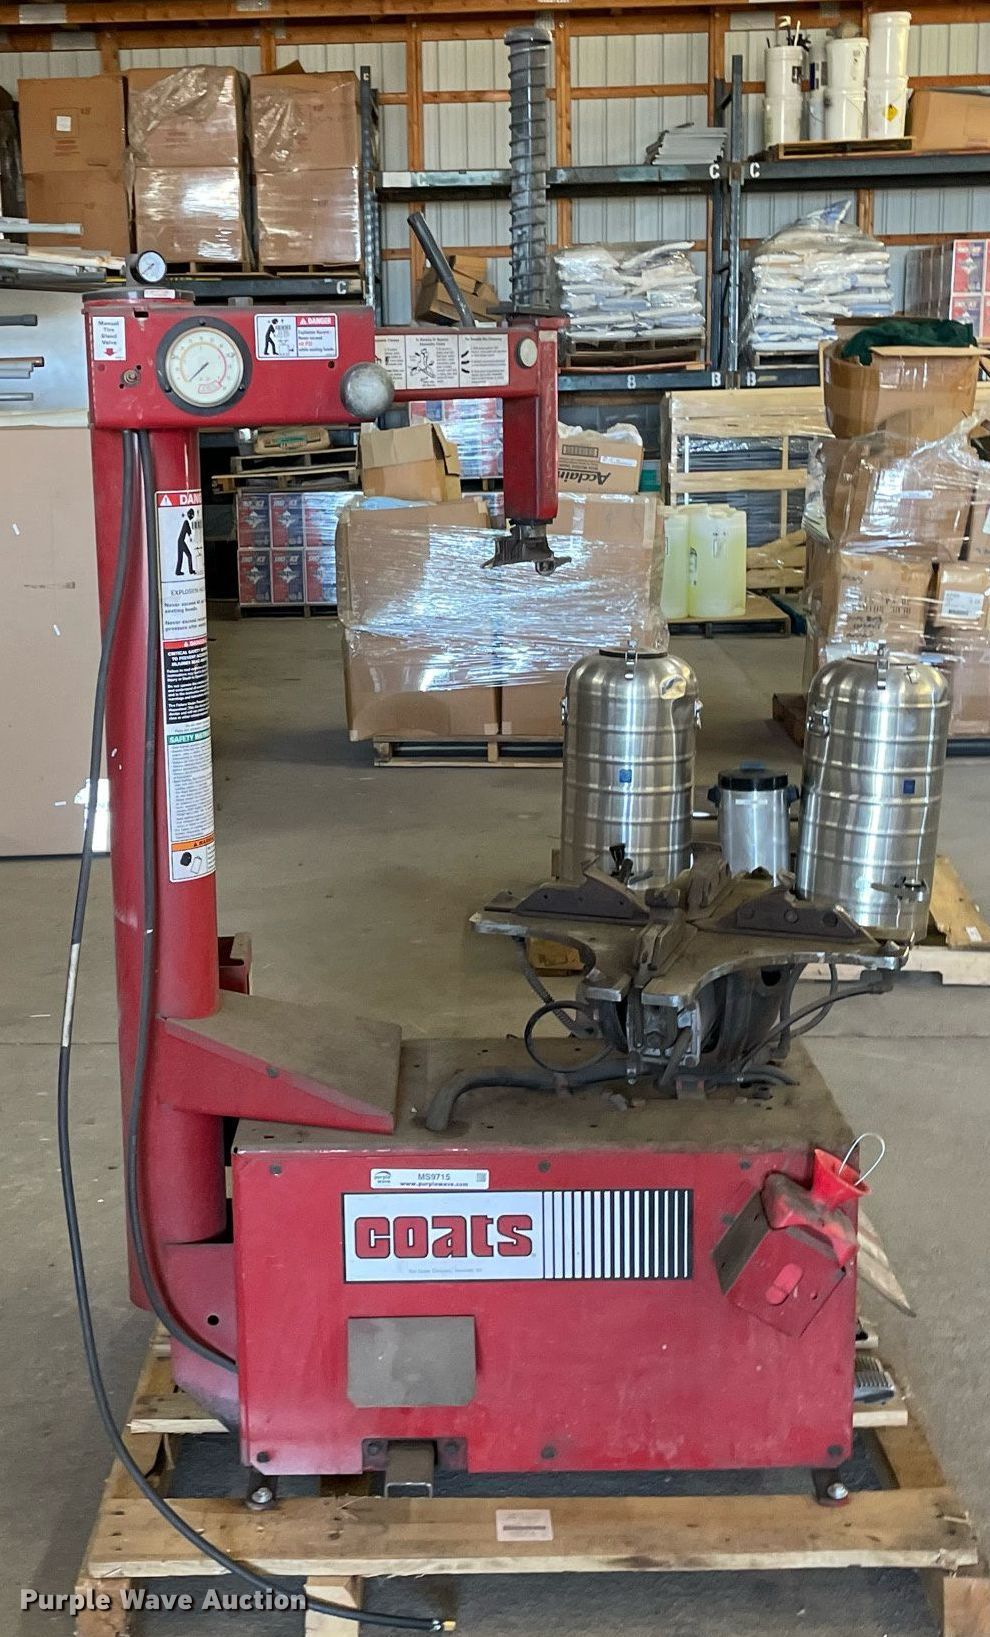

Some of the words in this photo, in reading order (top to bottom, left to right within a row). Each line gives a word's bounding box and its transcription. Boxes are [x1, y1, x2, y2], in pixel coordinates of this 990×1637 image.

[709, 163, 720, 179] C
[750, 162, 760, 178] C
[336, 280, 347, 295] C
[711, 371, 721, 387] B
[747, 371, 757, 386] B
[180, 494, 202, 505] DAN
[169, 734, 195, 744] SAFETY
[418, 1173, 450, 1181] MS9715
[354, 1214, 534, 1260] coats
